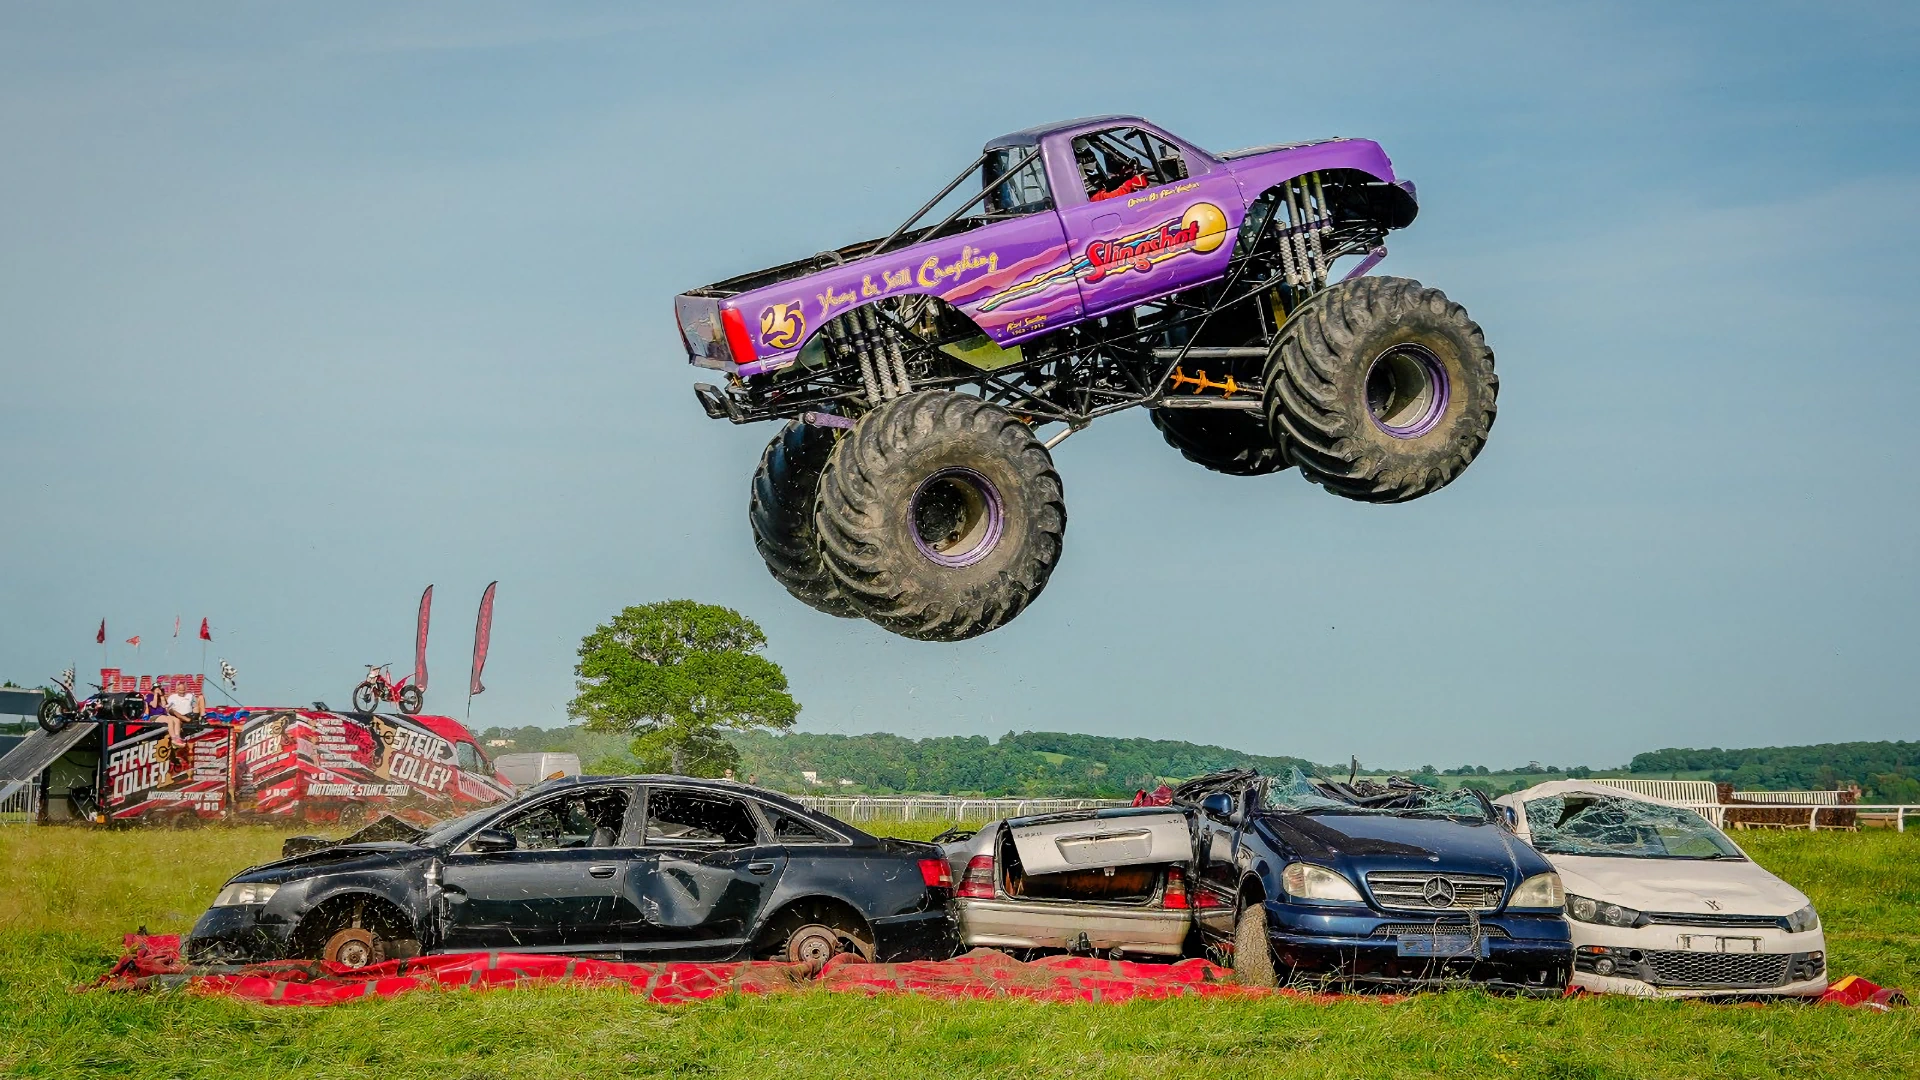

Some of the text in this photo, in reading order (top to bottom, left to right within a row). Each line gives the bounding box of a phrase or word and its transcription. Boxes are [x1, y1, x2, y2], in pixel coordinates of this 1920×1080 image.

[882, 267, 912, 295] Still
[917, 246, 999, 288] Crashing
[1084, 220, 1200, 283] Slingshot
[760, 300, 803, 347] 25
[245, 721, 275, 748] STEVE
[246, 735, 283, 765] COLLEY
[391, 727, 450, 763] STEVE
[108, 740, 159, 777] STEVE
[388, 753, 453, 792] COLLEY
[113, 760, 170, 799] COLLEY
[306, 783, 356, 797] MOTORBIKE
[356, 784, 385, 797] STUNT
